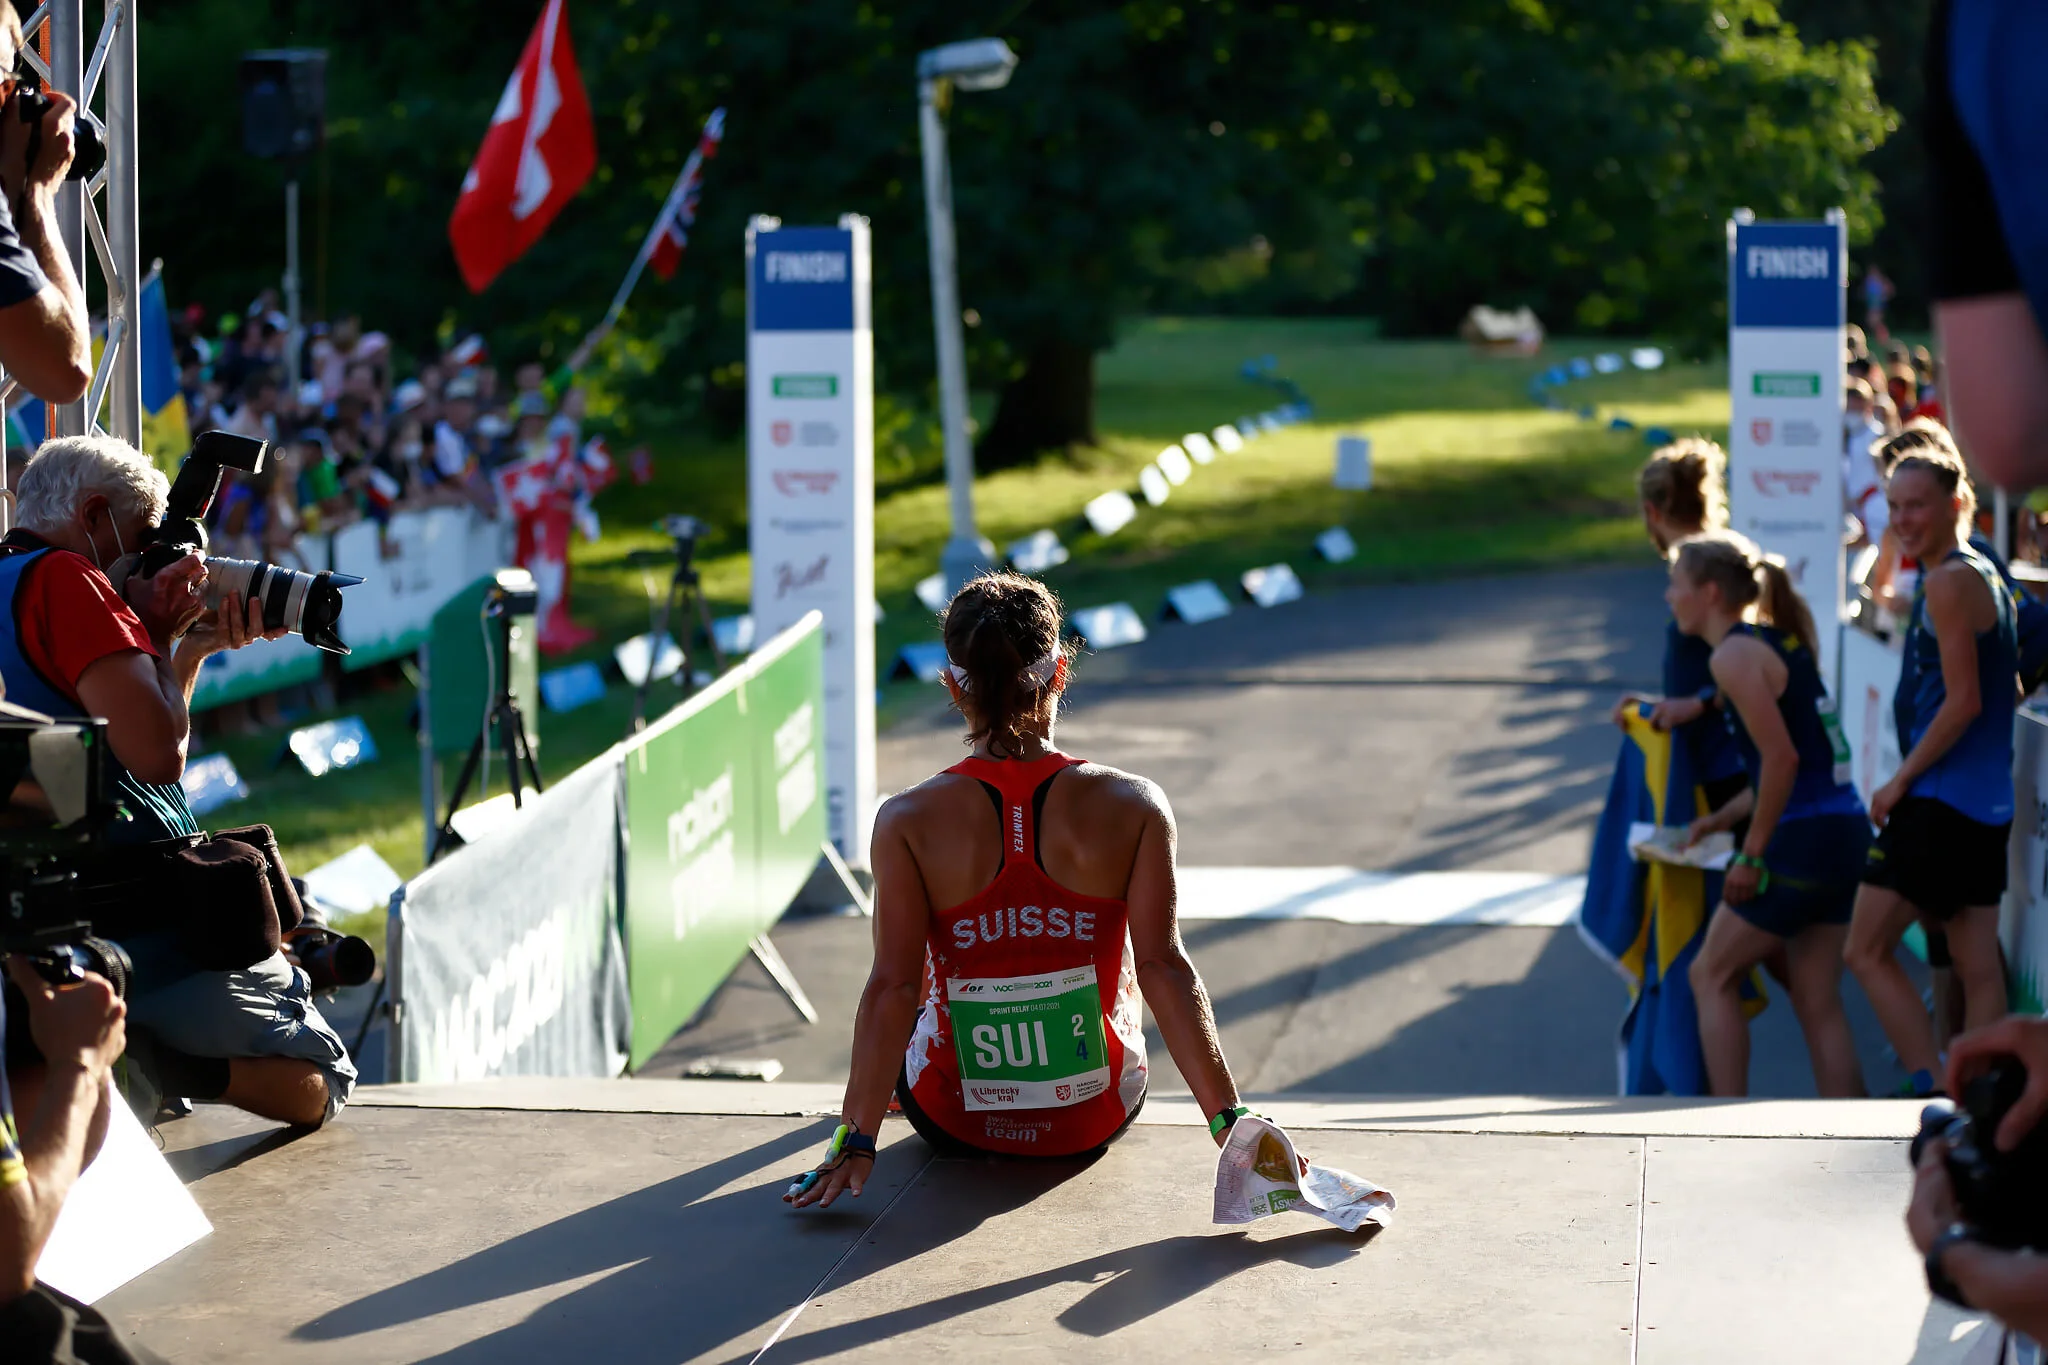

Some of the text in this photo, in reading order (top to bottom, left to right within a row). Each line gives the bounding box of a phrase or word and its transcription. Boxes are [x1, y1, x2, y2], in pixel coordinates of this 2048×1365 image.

[765, 251, 846, 282] FINISH
[1747, 247, 1828, 278] FINISH
[1013, 805, 1023, 853] TRIMTEX
[953, 904, 1097, 949] SUISSE
[1034, 980, 1053, 989] 2021
[989, 1007, 1010, 1015] SPRINT
[1011, 1005, 1029, 1013] RELAY
[1071, 1014, 1085, 1037] 2
[972, 1020, 1049, 1069] SUI
[1076, 1037, 1089, 1060] 4
[998, 1092, 1014, 1103] kraj
[985, 1127, 1037, 1142] team
